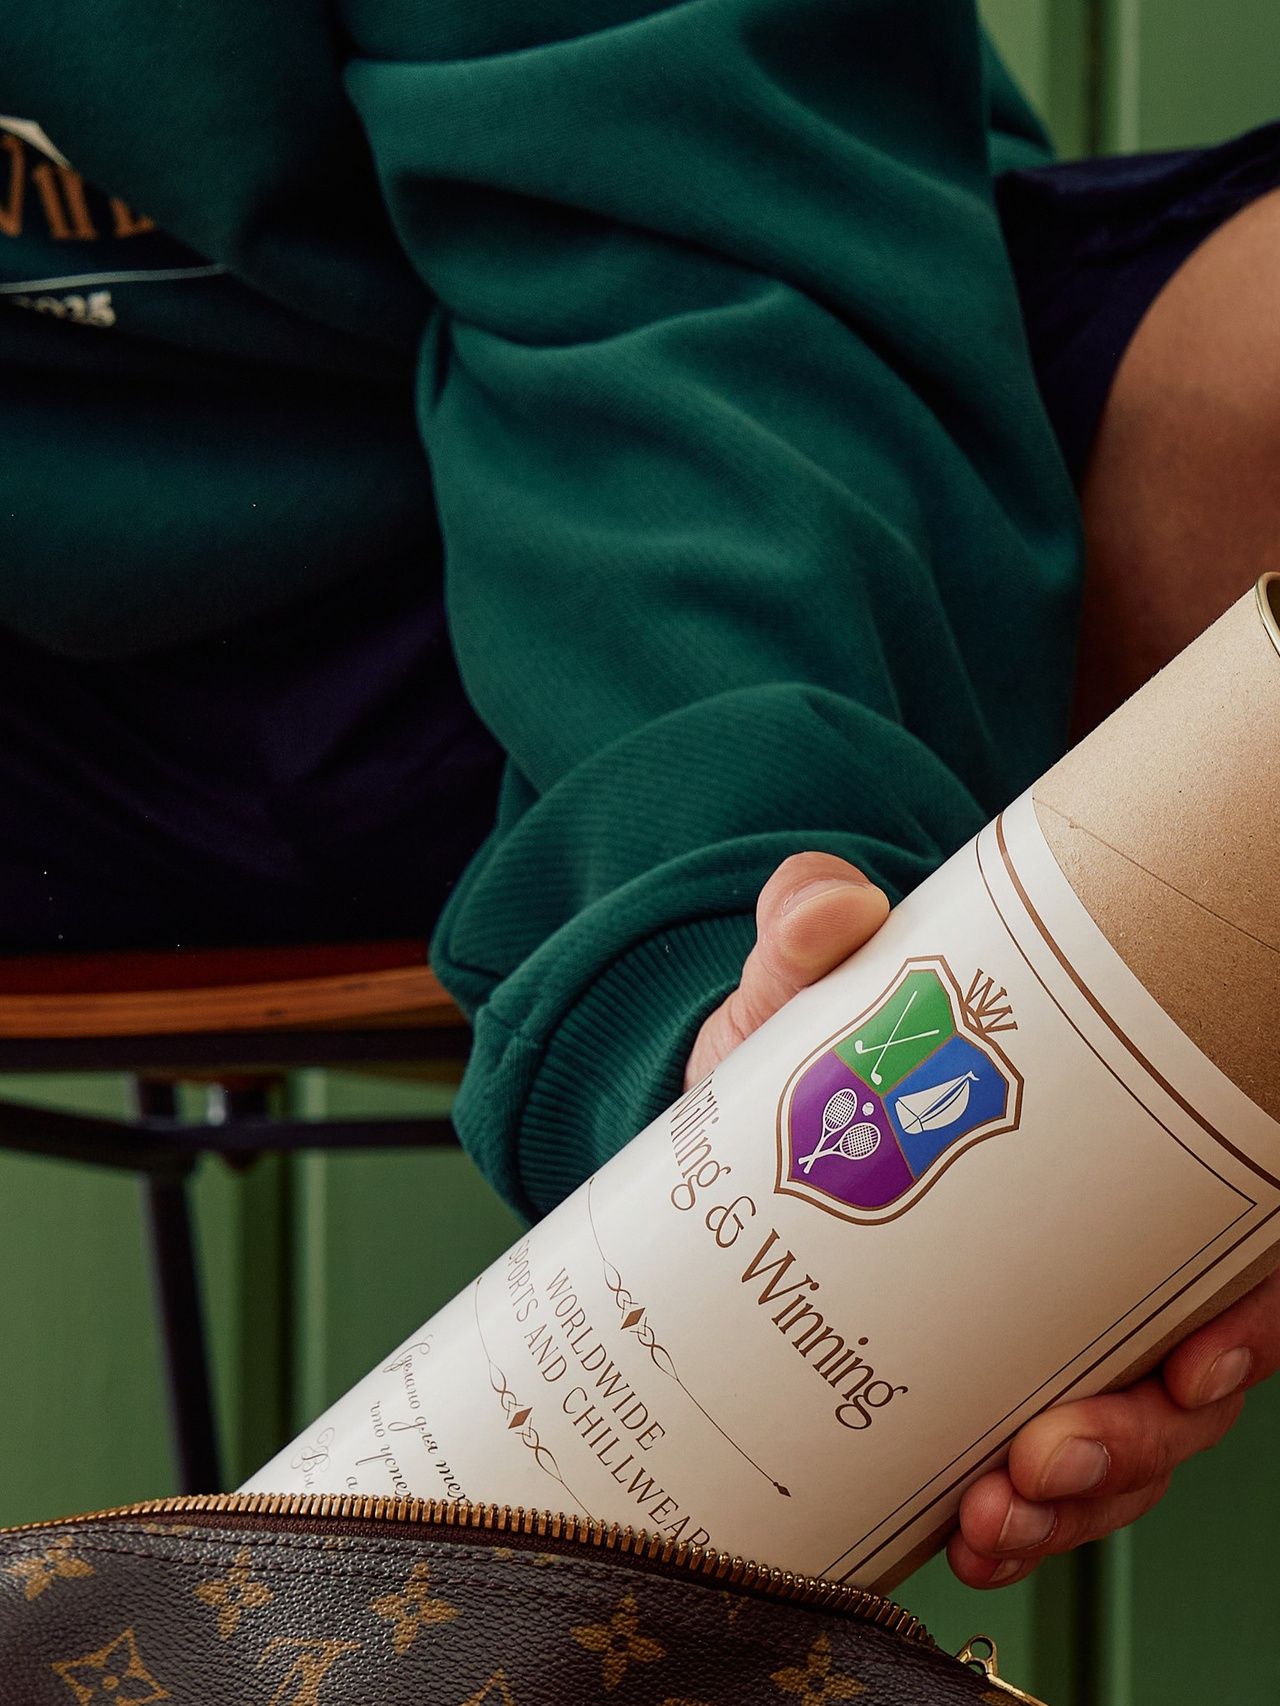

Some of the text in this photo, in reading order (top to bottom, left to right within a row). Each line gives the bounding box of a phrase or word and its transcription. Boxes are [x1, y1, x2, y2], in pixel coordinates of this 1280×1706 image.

[507, 1239, 539, 1323] SPORTS
[524, 1323, 568, 1383] AND
[670, 1070, 909, 1431] Willing & Winning
[382, 1334, 434, 1410] Сделано
[545, 1266, 666, 1451] WORLDWIDE
[387, 1416, 439, 1454] для
